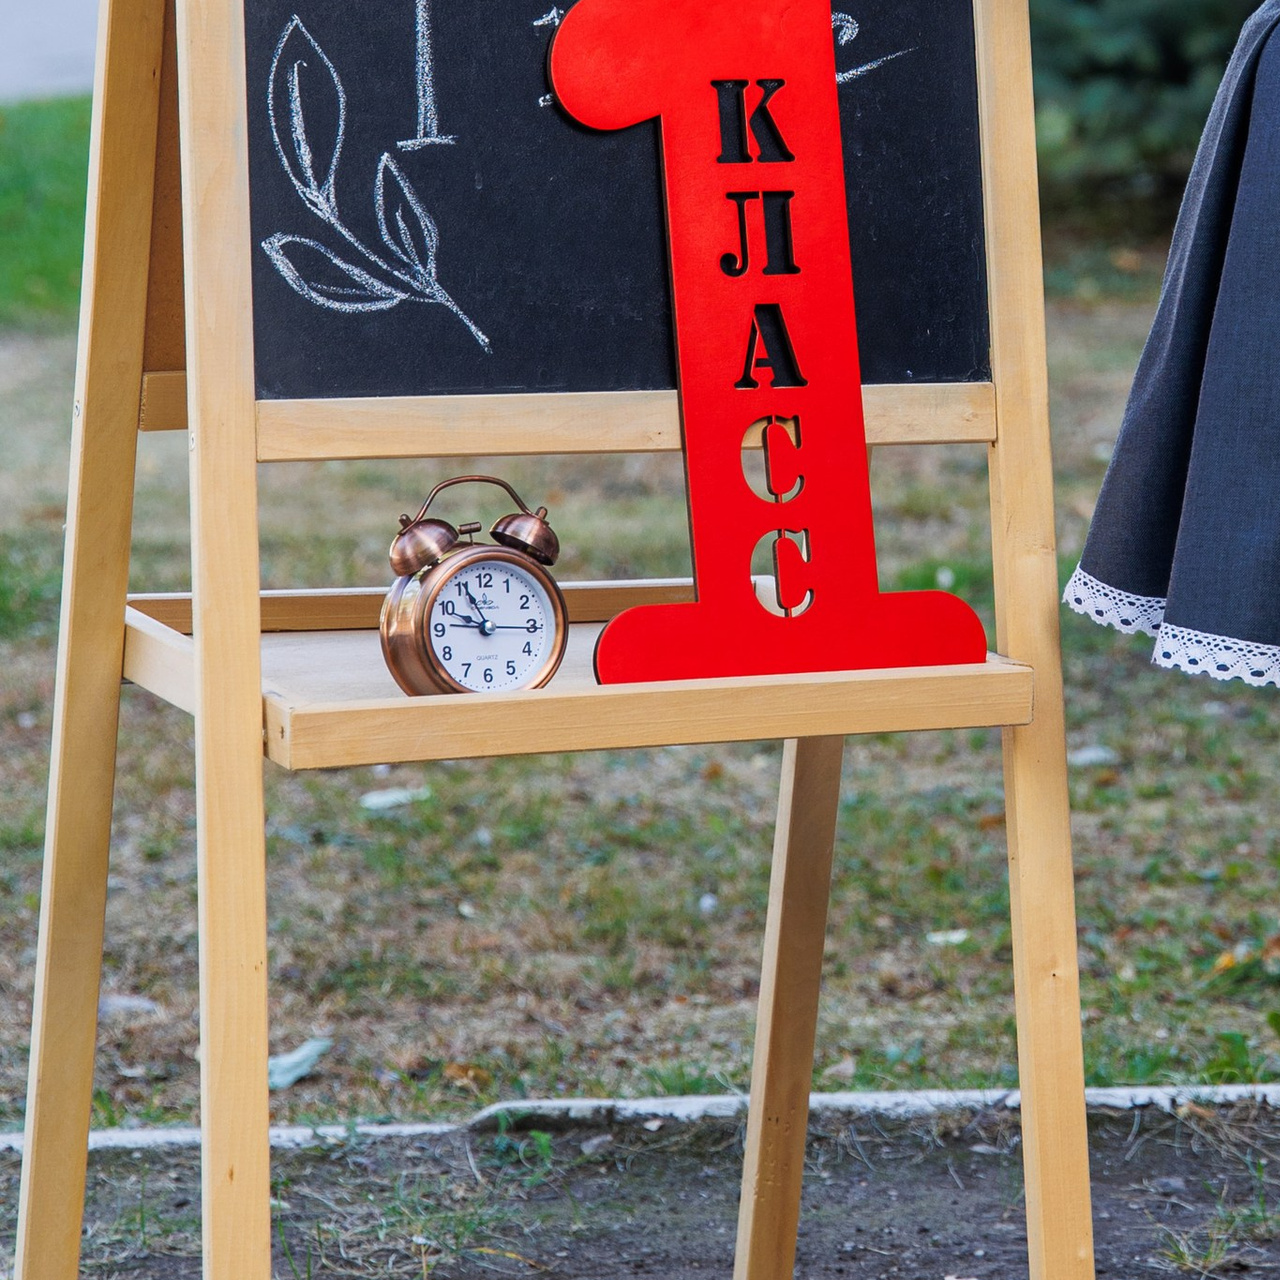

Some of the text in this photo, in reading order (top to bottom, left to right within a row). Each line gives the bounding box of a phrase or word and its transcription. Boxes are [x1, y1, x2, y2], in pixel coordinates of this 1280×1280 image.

[710, 78, 817, 619] КЛАСС
[475, 573, 493, 588] 12
[502, 578, 510, 593] 1
[454, 581, 469, 596] 11
[438, 600, 455, 616] 10
[519, 594, 530, 610] 2
[433, 622, 446, 638] 9
[526, 618, 538, 633] 3
[442, 645, 453, 661] 8
[522, 641, 532, 656] 4
[461, 662, 472, 678] 7
[506, 660, 516, 675] 5
[483, 668, 493, 683] 6
